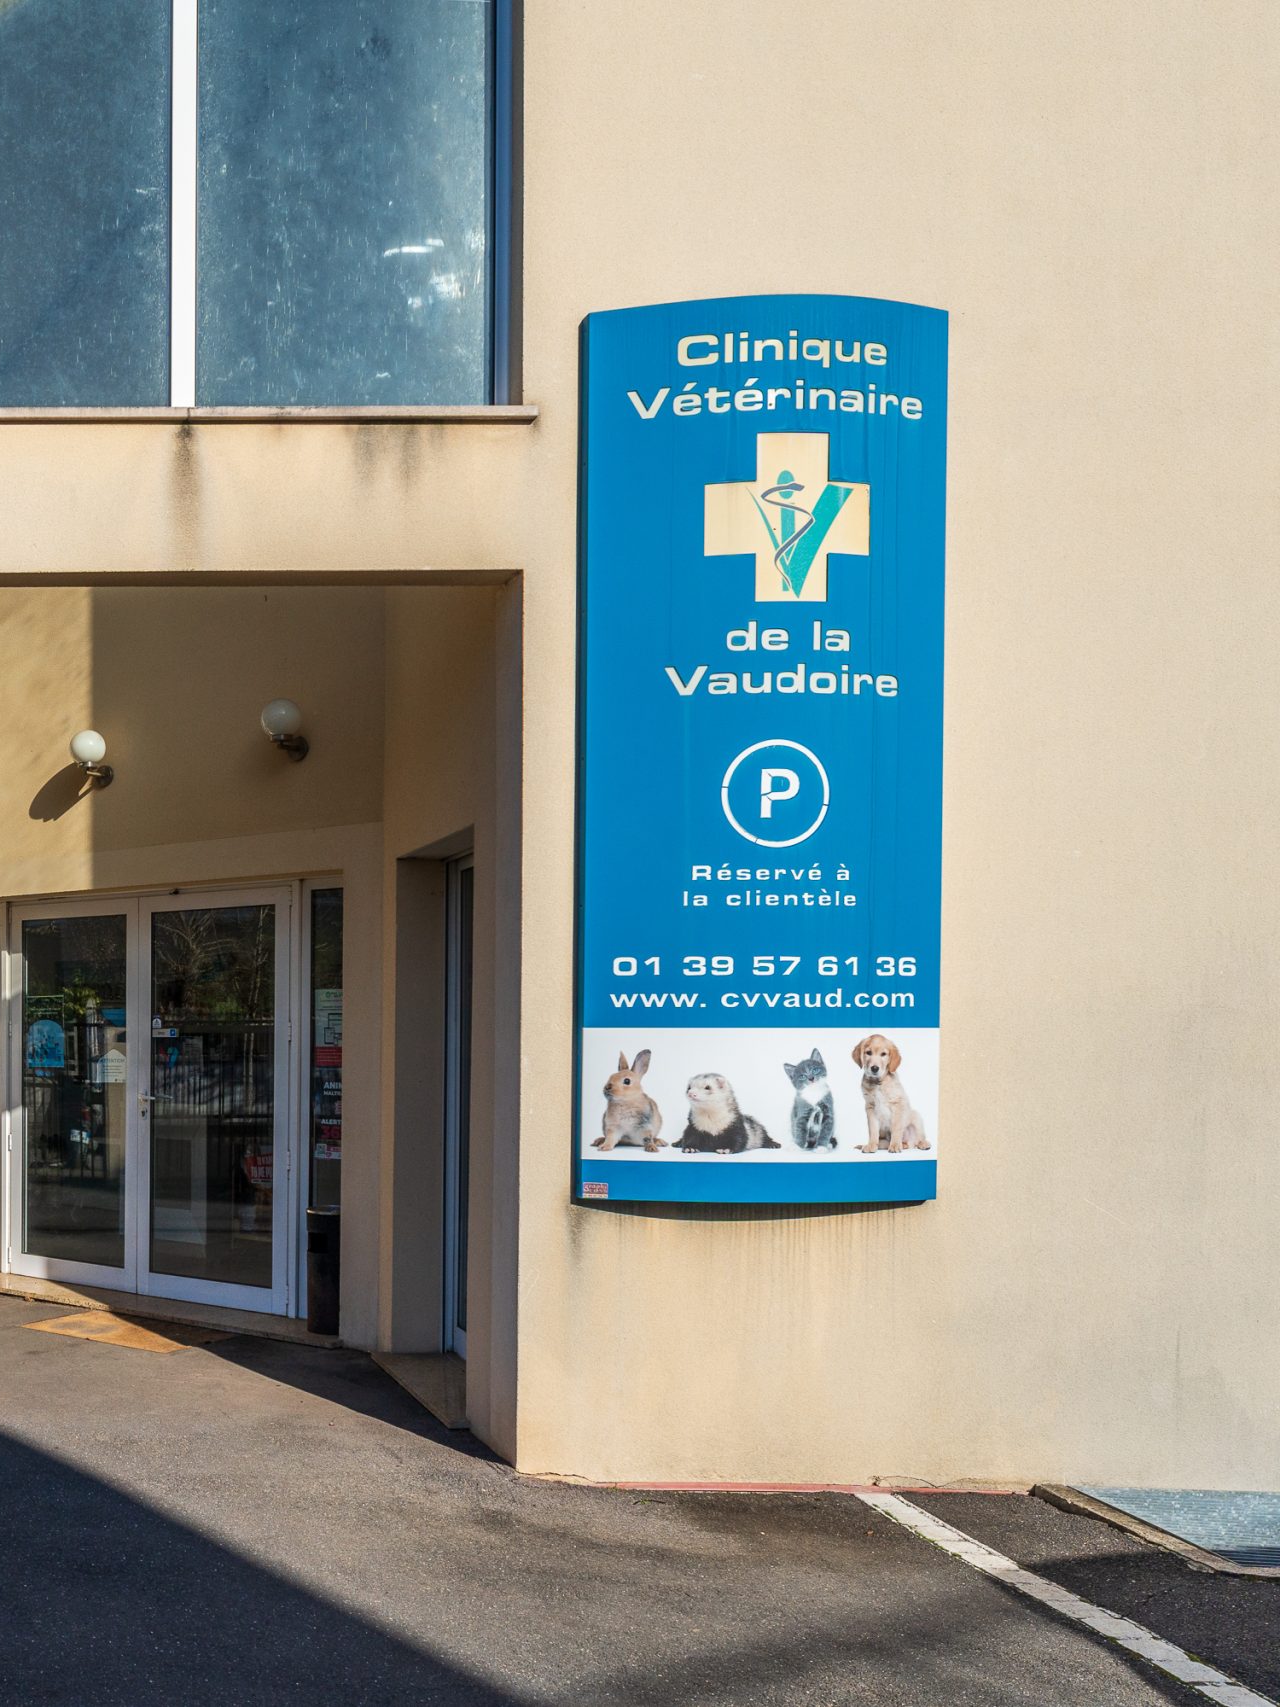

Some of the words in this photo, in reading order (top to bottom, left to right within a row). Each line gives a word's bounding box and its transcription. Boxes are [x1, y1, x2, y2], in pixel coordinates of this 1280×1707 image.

[677, 330, 887, 369] Clinique
[627, 377, 923, 420] Vétérinaire
[726, 620, 789, 652] de
[813, 620, 850, 652] la
[664, 663, 898, 697] Vaudoire
[760, 768, 801, 819] P
[691, 862, 822, 881] Réservé
[836, 863, 850, 881] à
[683, 890, 708, 907] la
[726, 888, 857, 907] clientèle
[612, 956, 660, 977] 01
[682, 955, 734, 976] 39
[752, 955, 801, 976] 57
[817, 955, 858, 976] 61
[876, 956, 917, 977] 36
[609, 993, 706, 1008] www.
[720, 988, 915, 1008] cvvaud.com
